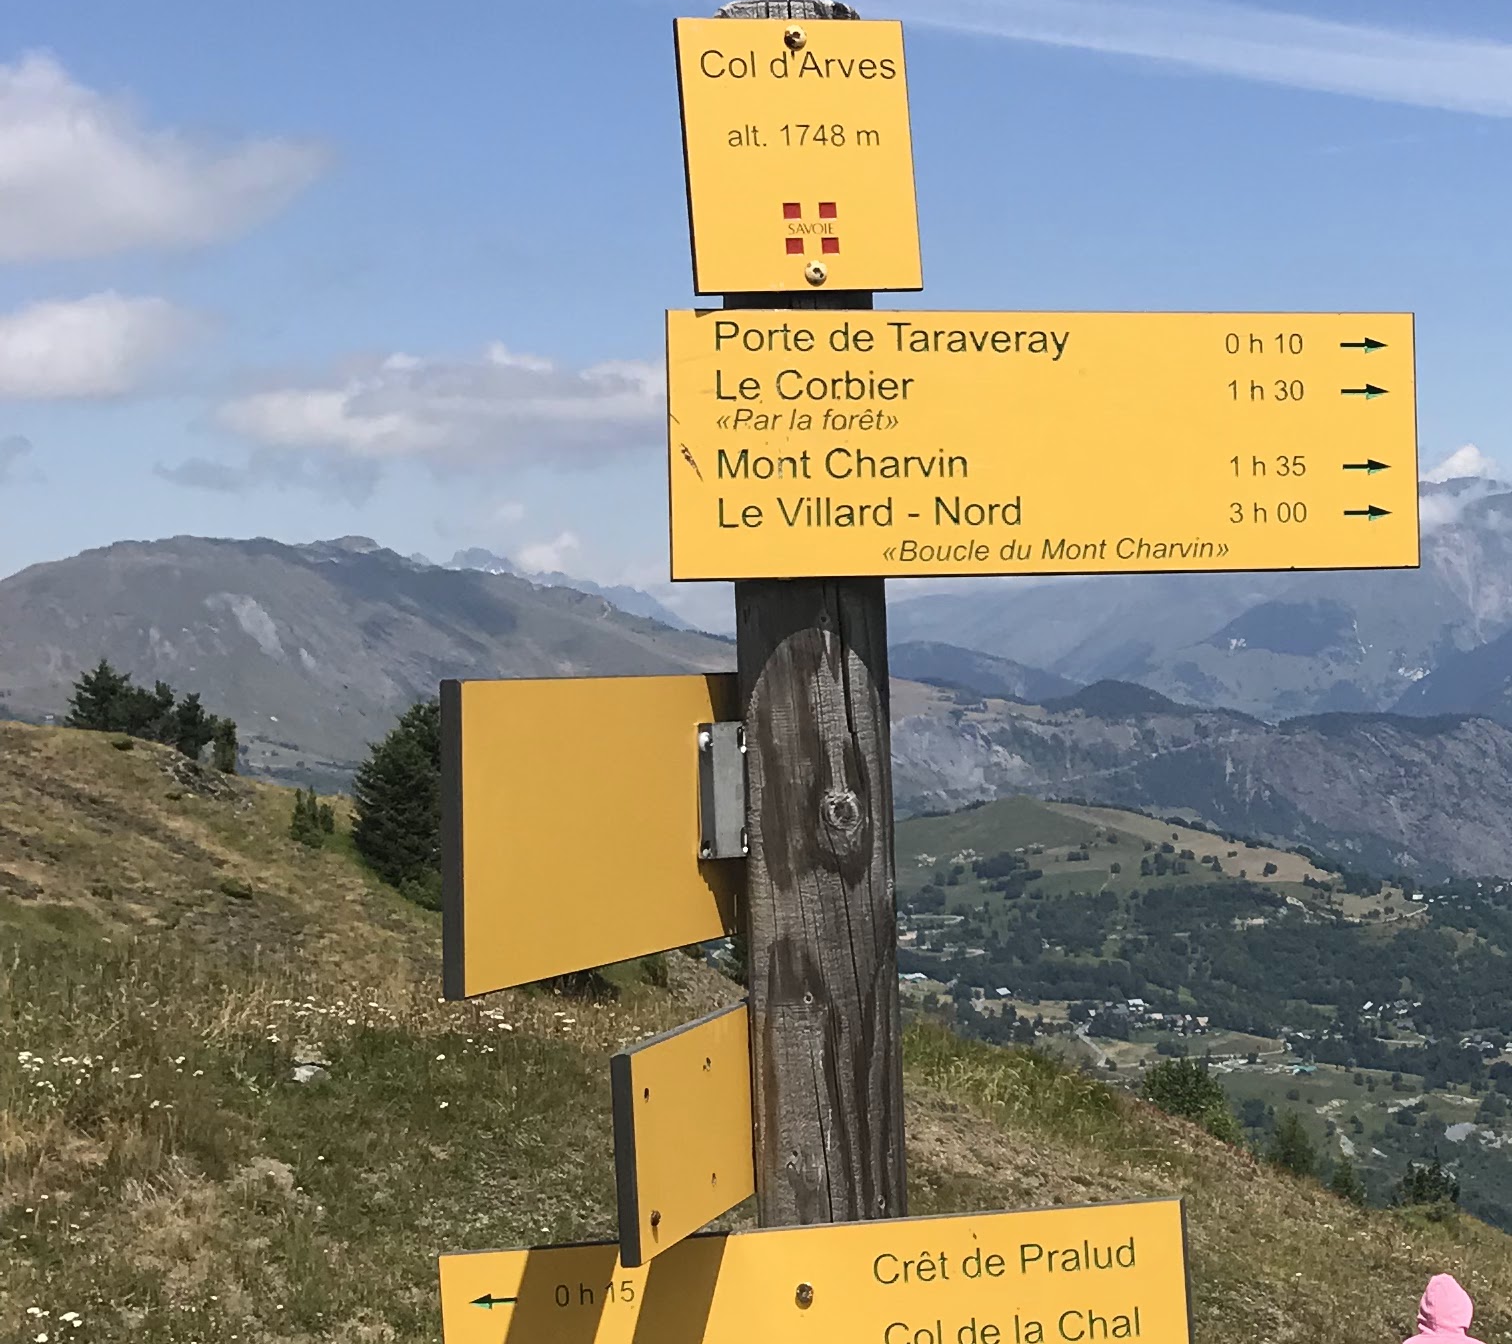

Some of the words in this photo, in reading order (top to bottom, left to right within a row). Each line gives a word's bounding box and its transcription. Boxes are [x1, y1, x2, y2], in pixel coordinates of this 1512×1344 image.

[701, 50, 756, 79] Col
[770, 48, 897, 80] d'Arves
[728, 124, 766, 147] alt.
[780, 124, 846, 147] 1748
[857, 129, 881, 147] m
[787, 222, 835, 235] SAVOIE
[715, 321, 815, 353] Porte
[829, 322, 875, 353] de
[887, 321, 1070, 362] Taraveray
[1225, 333, 1240, 355] 0
[1250, 332, 1264, 354] h
[1275, 333, 1304, 355] 10
[716, 370, 761, 402] Le
[776, 369, 916, 402] Corbier
[1228, 379, 1238, 402] 1
[1250, 379, 1265, 402] h
[1275, 379, 1305, 402] 30
[716, 408, 782, 432] «Par
[789, 408, 813, 432] la
[822, 407, 900, 432] forêt»
[718, 449, 812, 480] Mont
[825, 448, 968, 480] Charvin
[1229, 456, 1239, 478] 1
[1252, 455, 1267, 477] h
[1276, 455, 1307, 477] 35
[719, 498, 764, 529] Le
[776, 497, 893, 529] Villard
[935, 496, 1022, 527] Nord
[1229, 502, 1244, 524] 3
[1254, 501, 1268, 524] h
[1277, 501, 1308, 524] 00
[882, 539, 990, 563] «Boucle
[1000, 539, 1033, 562] du
[1041, 538, 1108, 560] Mont
[1116, 538, 1230, 560] Charvin»
[873, 1251, 951, 1285] Crêt
[962, 1246, 1006, 1280] de
[1020, 1236, 1136, 1276] Pralud
[555, 1285, 570, 1308] 0
[580, 1282, 594, 1306] h
[605, 1280, 636, 1304] 15
[1059, 1306, 1141, 1342] Chal
